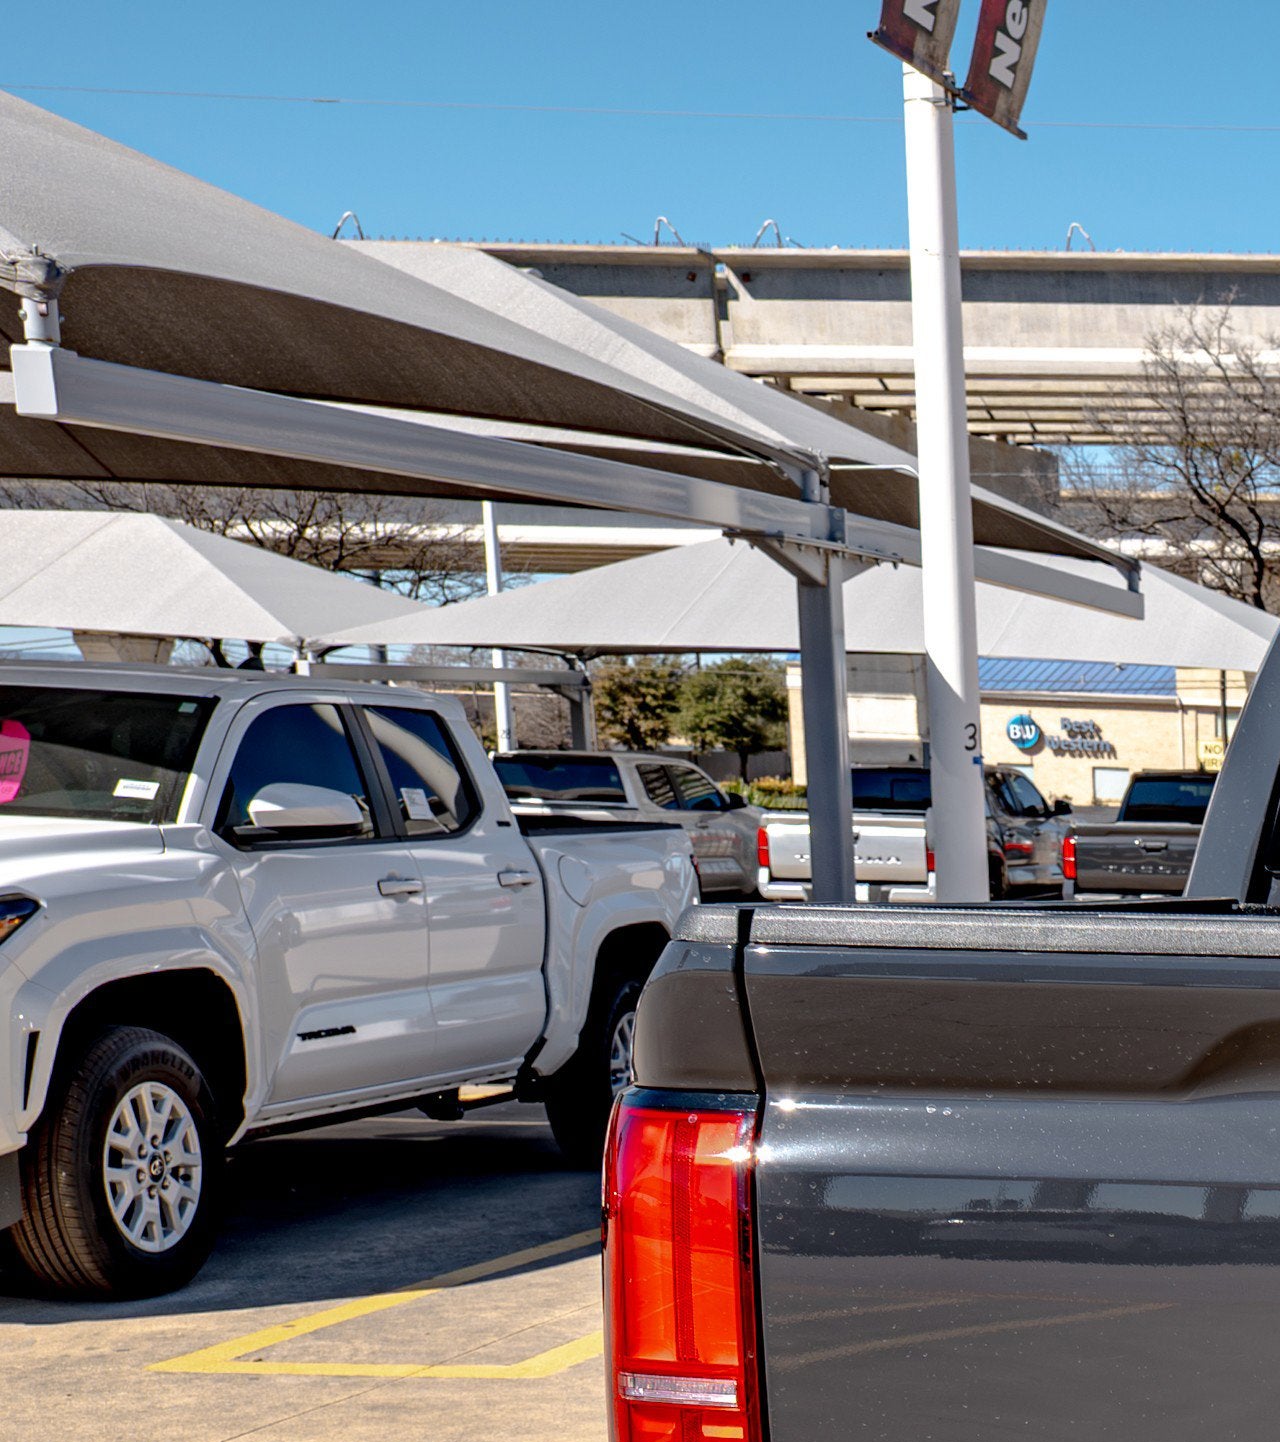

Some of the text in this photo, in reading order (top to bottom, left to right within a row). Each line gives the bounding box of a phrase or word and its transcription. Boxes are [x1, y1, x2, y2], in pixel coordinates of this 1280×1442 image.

[1060, 717, 1095, 733] Best
[964, 722, 977, 750] 3
[1044, 734, 1111, 751] Western
